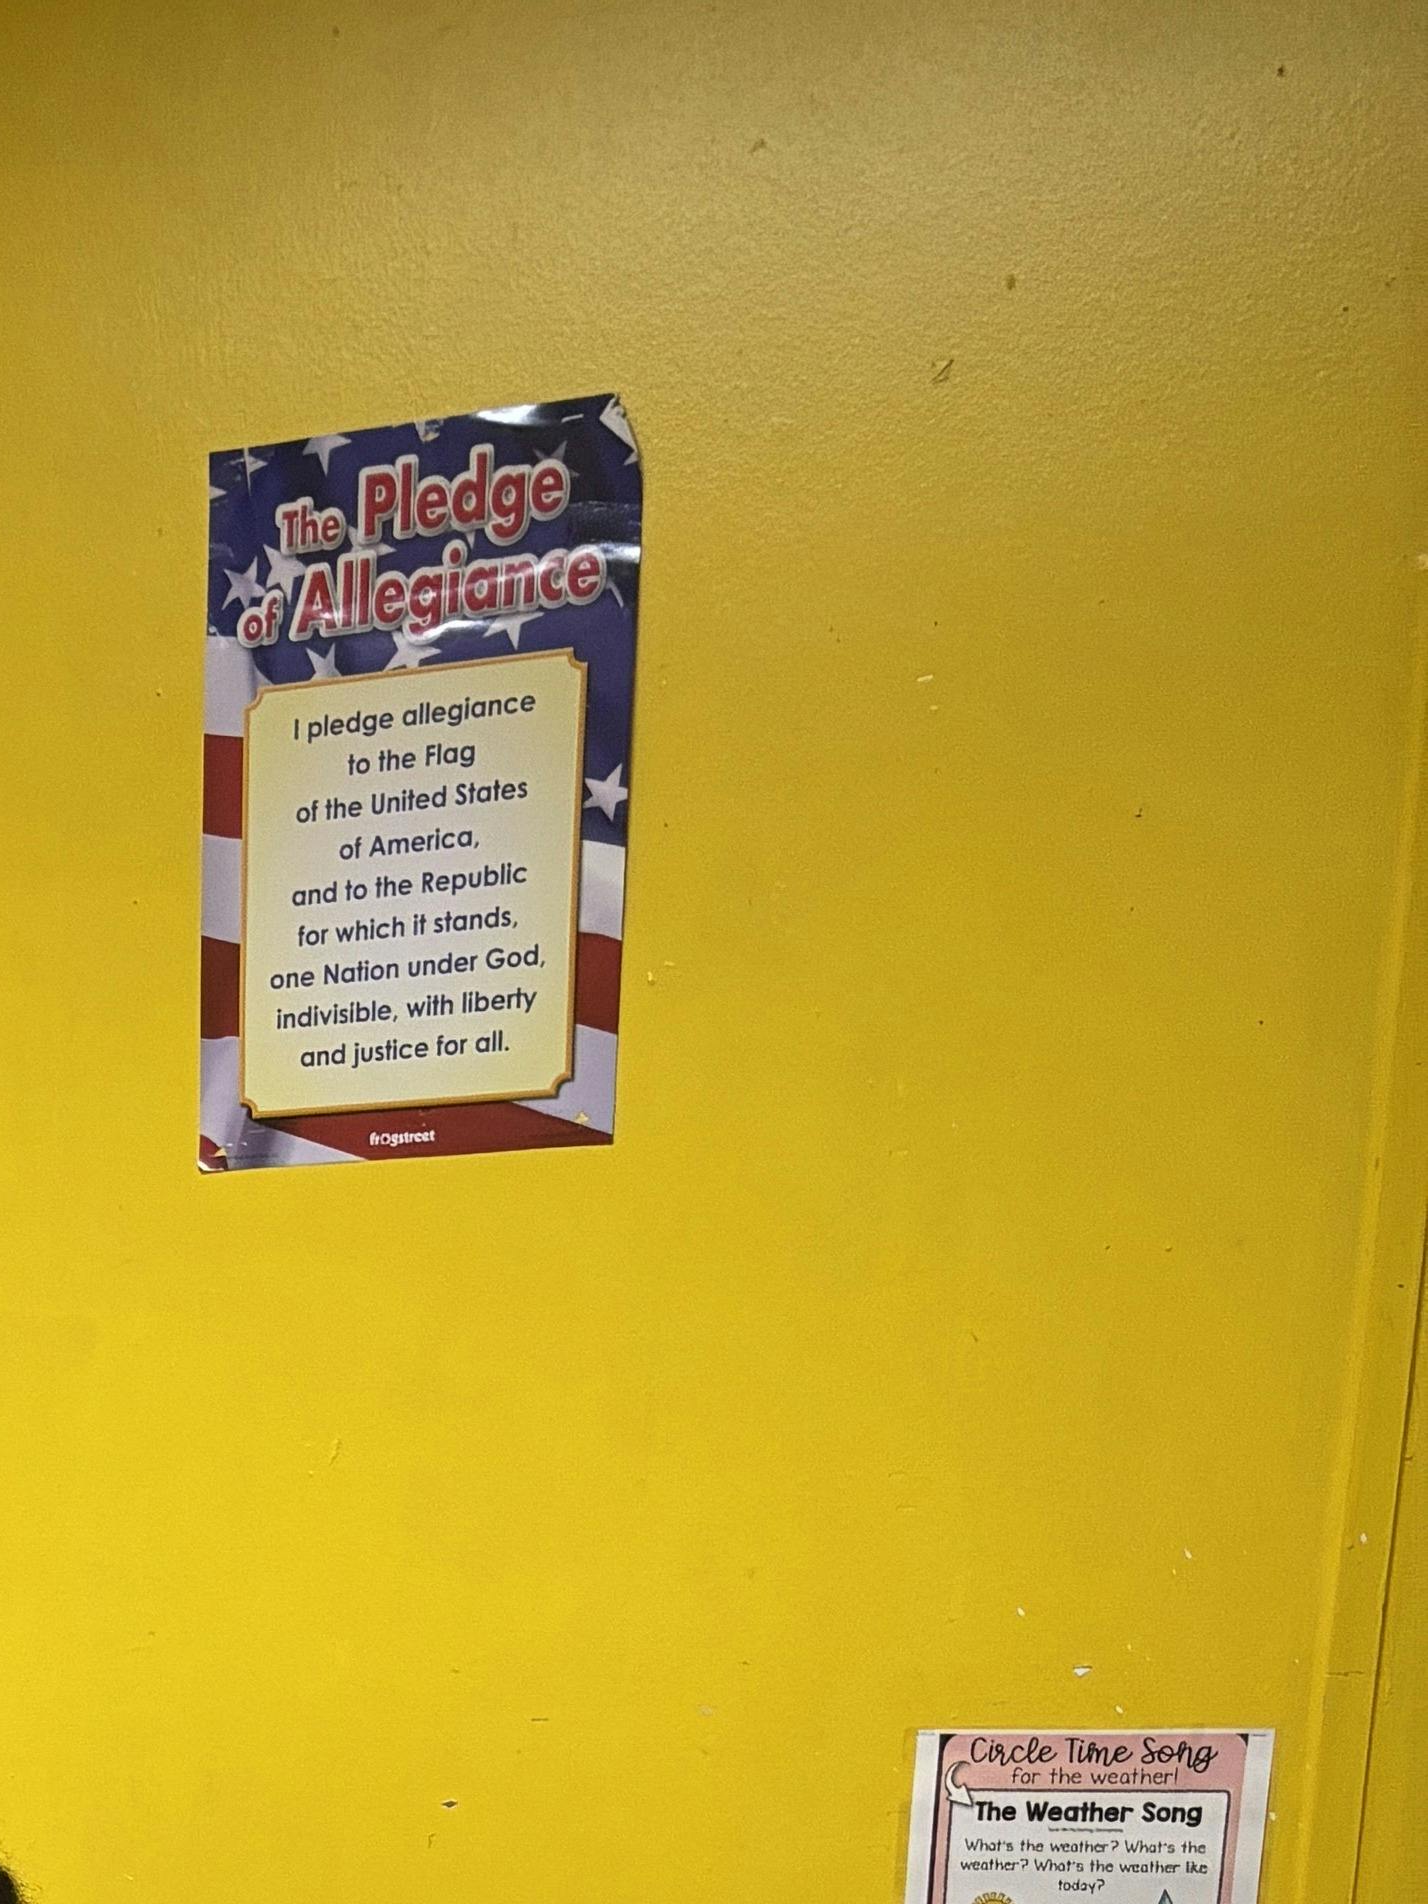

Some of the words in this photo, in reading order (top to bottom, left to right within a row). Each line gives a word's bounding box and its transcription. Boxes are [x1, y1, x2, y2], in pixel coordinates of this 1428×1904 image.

[278, 500, 342, 551] The
[360, 448, 568, 542] Pledge
[240, 594, 281, 644] of
[292, 543, 604, 640] Allegiance
[294, 718, 299, 741] I
[307, 710, 394, 744] pledge
[402, 695, 536, 727] allegiance
[348, 753, 370, 776] to
[378, 749, 416, 772] the
[425, 743, 475, 768] Flag
[296, 800, 319, 823] of
[325, 797, 363, 820] the
[371, 785, 447, 815] United
[455, 779, 528, 806] States
[339, 836, 362, 860] of
[369, 827, 479, 857] America,
[292, 881, 337, 907] and
[345, 879, 368, 901] to
[375, 875, 413, 898] the
[422, 862, 528, 896] Republic
[298, 925, 329, 947] for
[335, 916, 405, 943] which
[413, 913, 427, 936] it
[433, 906, 518, 934] stands,
[270, 971, 315, 989] one
[324, 960, 399, 985] Nation
[408, 952, 478, 977] under
[485, 943, 545, 970] God,
[277, 1000, 398, 1030] indivisible,
[406, 994, 454, 1018] with
[462, 987, 538, 1014] liberty
[300, 1043, 346, 1067] and
[351, 1038, 429, 1069] justice
[436, 1034, 468, 1056] for
[475, 1029, 510, 1053] all.
[970, 1736, 1057, 1766] Circle
[1065, 1737, 1133, 1767] Time
[1140, 1736, 1218, 1773] Song
[1012, 1767, 1041, 1785] for
[1049, 1767, 1082, 1784] the
[1090, 1767, 1179, 1785] weather!
[975, 1801, 1017, 1822] The
[1026, 1800, 1135, 1823] Weather
[1141, 1801, 1203, 1828] Song
[964, 1837, 1014, 1852] What's
[1020, 1839, 1044, 1852] the
[1049, 1840, 1120, 1853] weather?
[1124, 1839, 1176, 1854] What's
[1181, 1840, 1206, 1854] the
[960, 1858, 1029, 1871] weather?
[1034, 1858, 1084, 1872] What's
[1090, 1859, 1114, 1873] the
[1119, 1860, 1181, 1874] weather
[1058, 1878, 1105, 1895] today?
